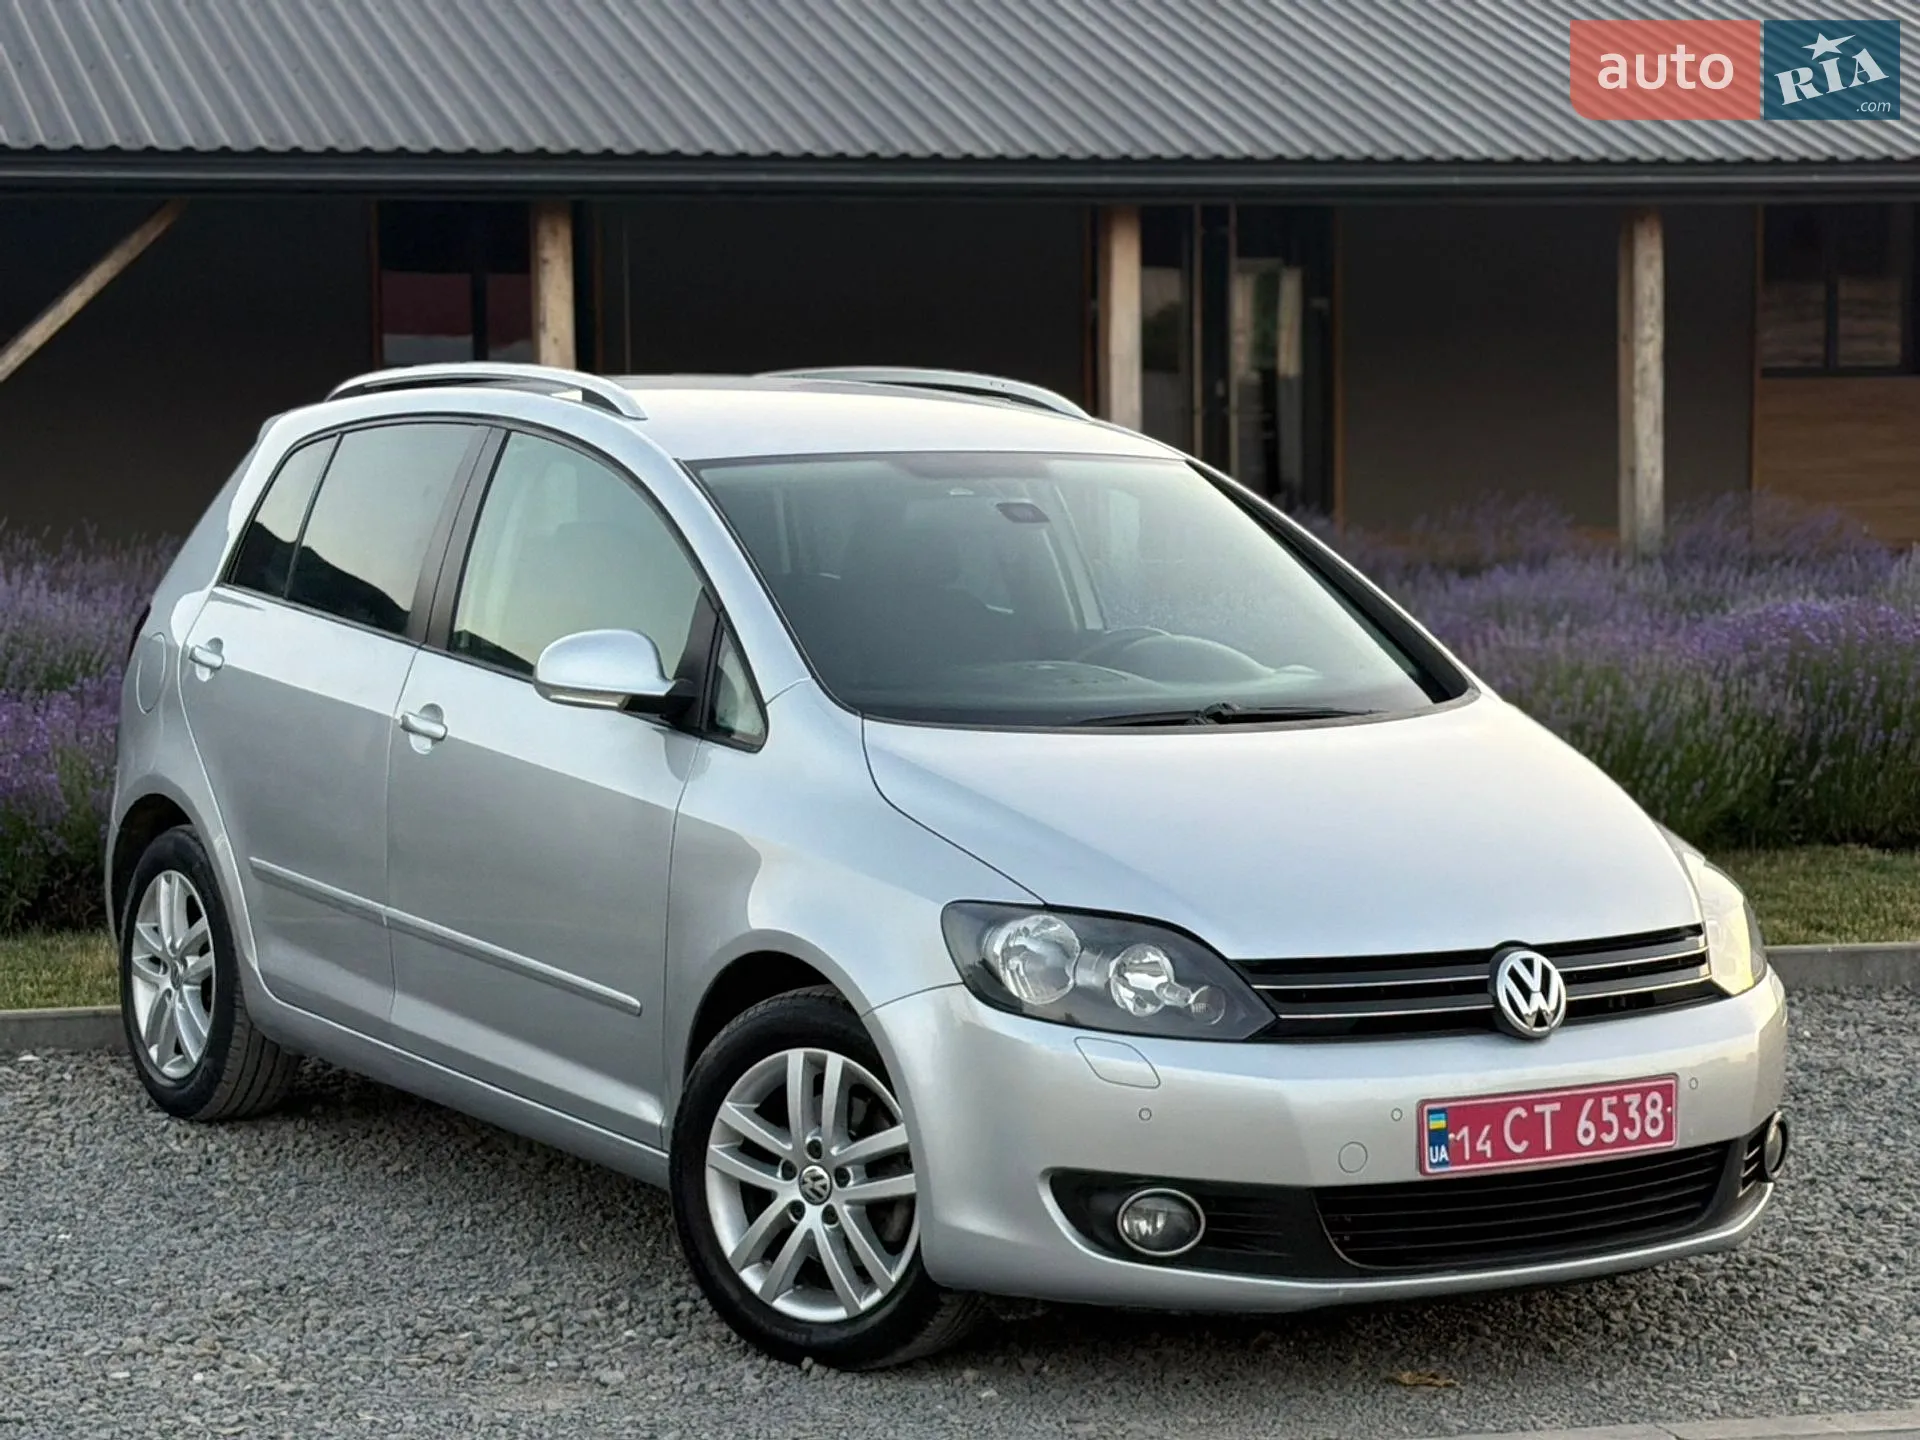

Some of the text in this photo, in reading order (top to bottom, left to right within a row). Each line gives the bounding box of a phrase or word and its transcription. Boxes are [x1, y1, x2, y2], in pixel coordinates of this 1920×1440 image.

[1498, 954, 1565, 1032] VW
[1430, 1146, 1449, 1163] UA
[1456, 1091, 1665, 1161] 14 CT 6538
